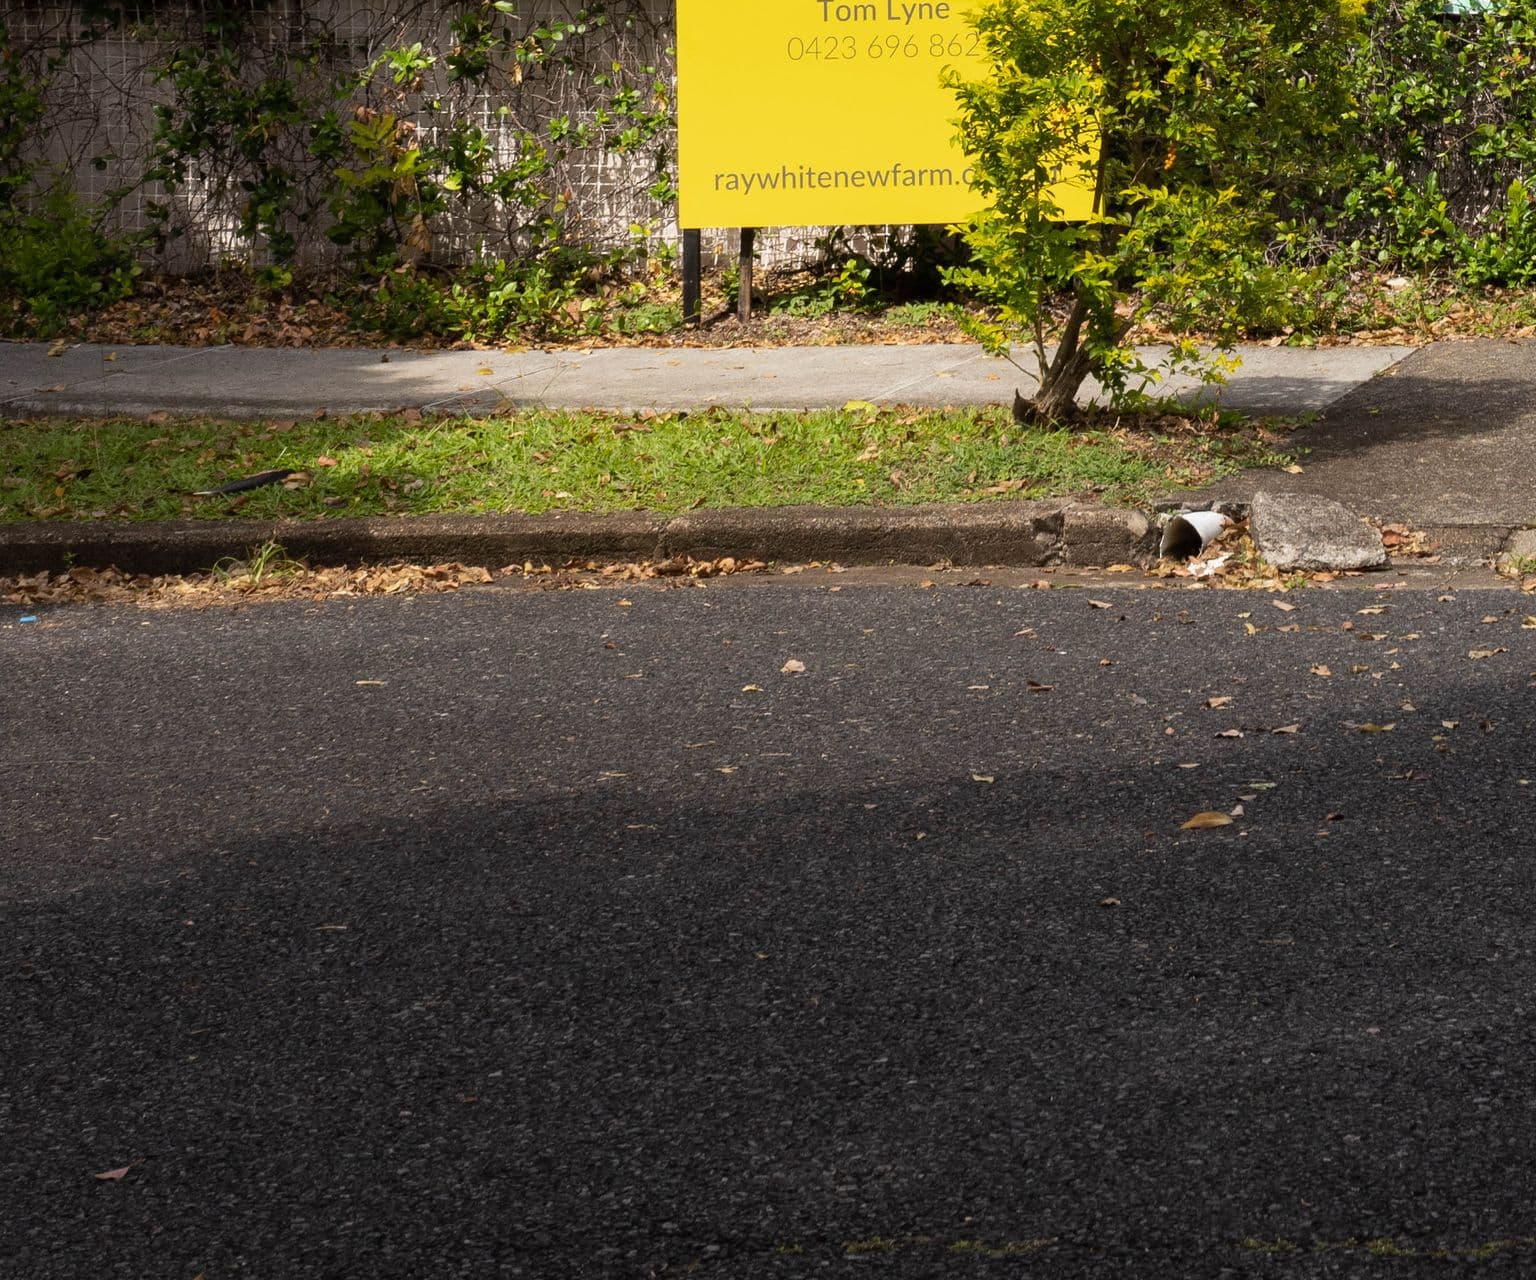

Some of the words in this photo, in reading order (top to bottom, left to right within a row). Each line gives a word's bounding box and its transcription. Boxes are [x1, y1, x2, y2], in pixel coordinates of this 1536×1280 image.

[787, 35, 857, 61] 0423
[868, 33, 919, 59] 696
[929, 32, 981, 57] 862
